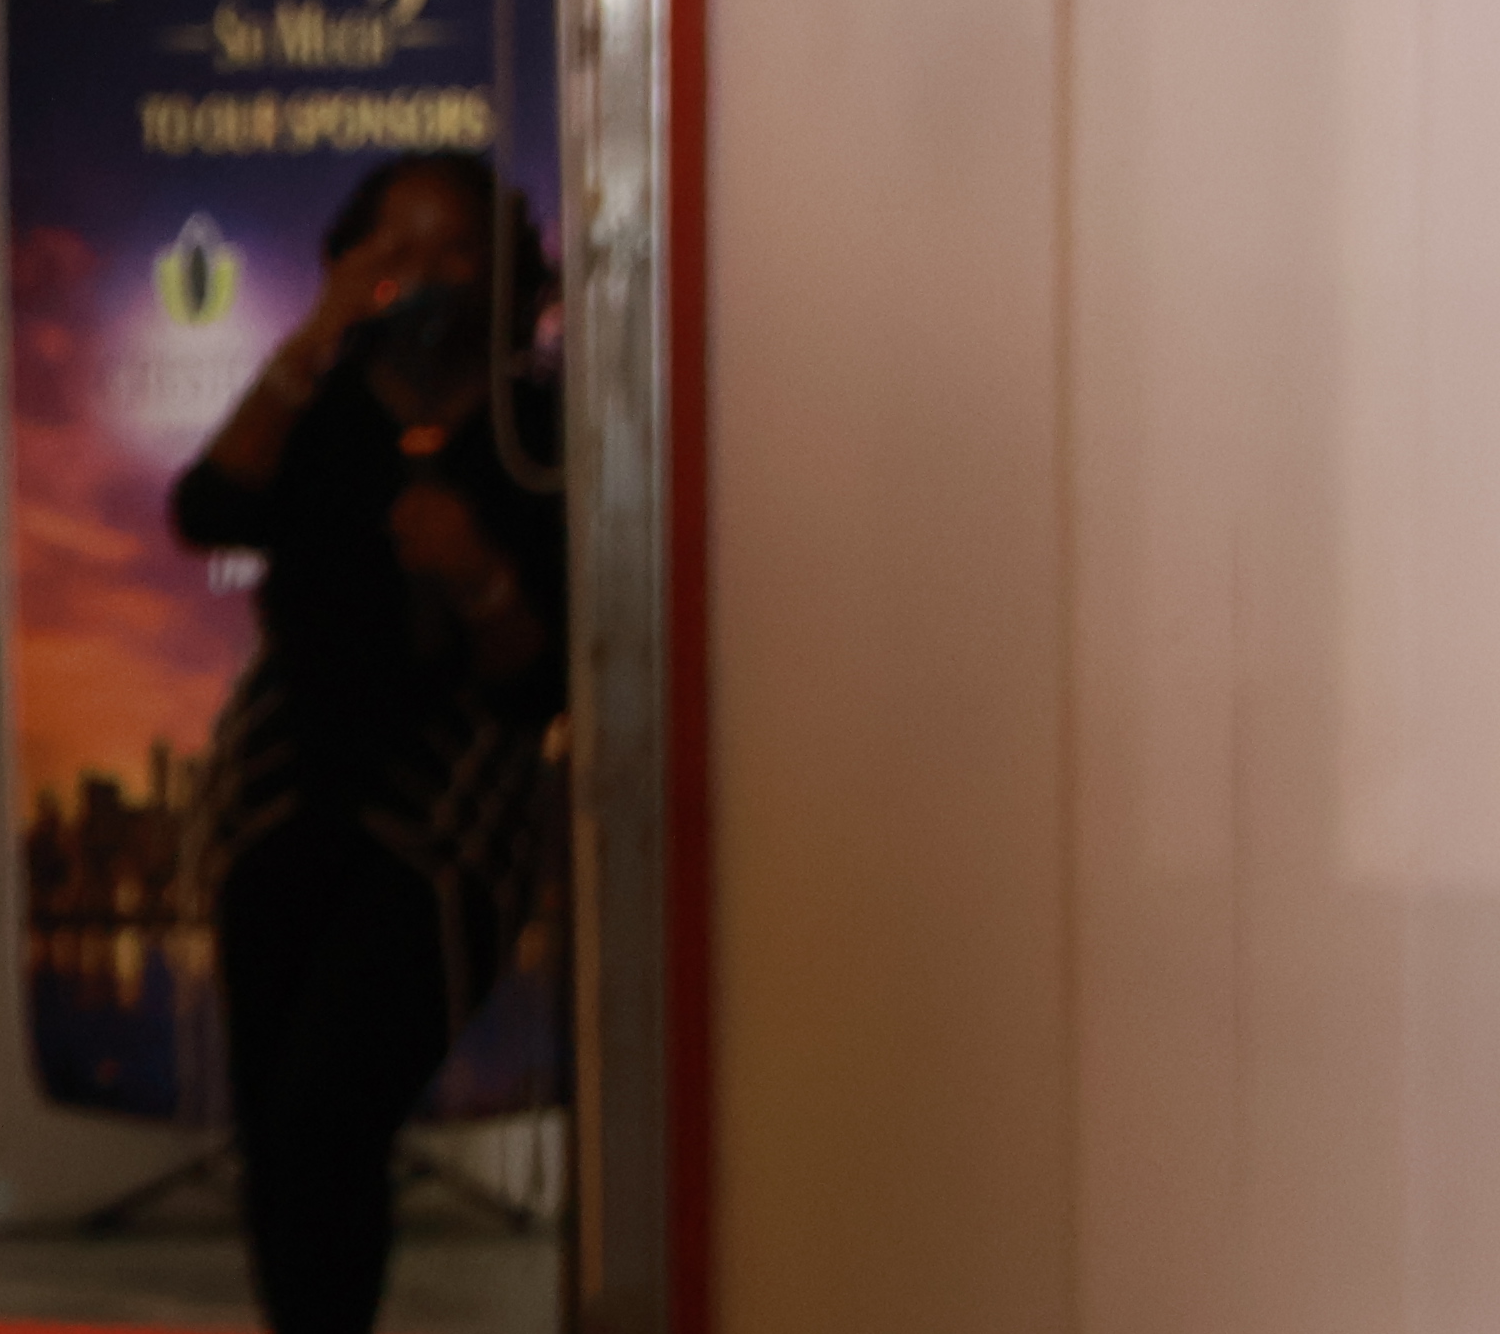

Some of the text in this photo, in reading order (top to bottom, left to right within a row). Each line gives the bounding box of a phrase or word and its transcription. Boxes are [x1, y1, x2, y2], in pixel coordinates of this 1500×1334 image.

[142, 85, 494, 154] TO OUR SPONSORS
